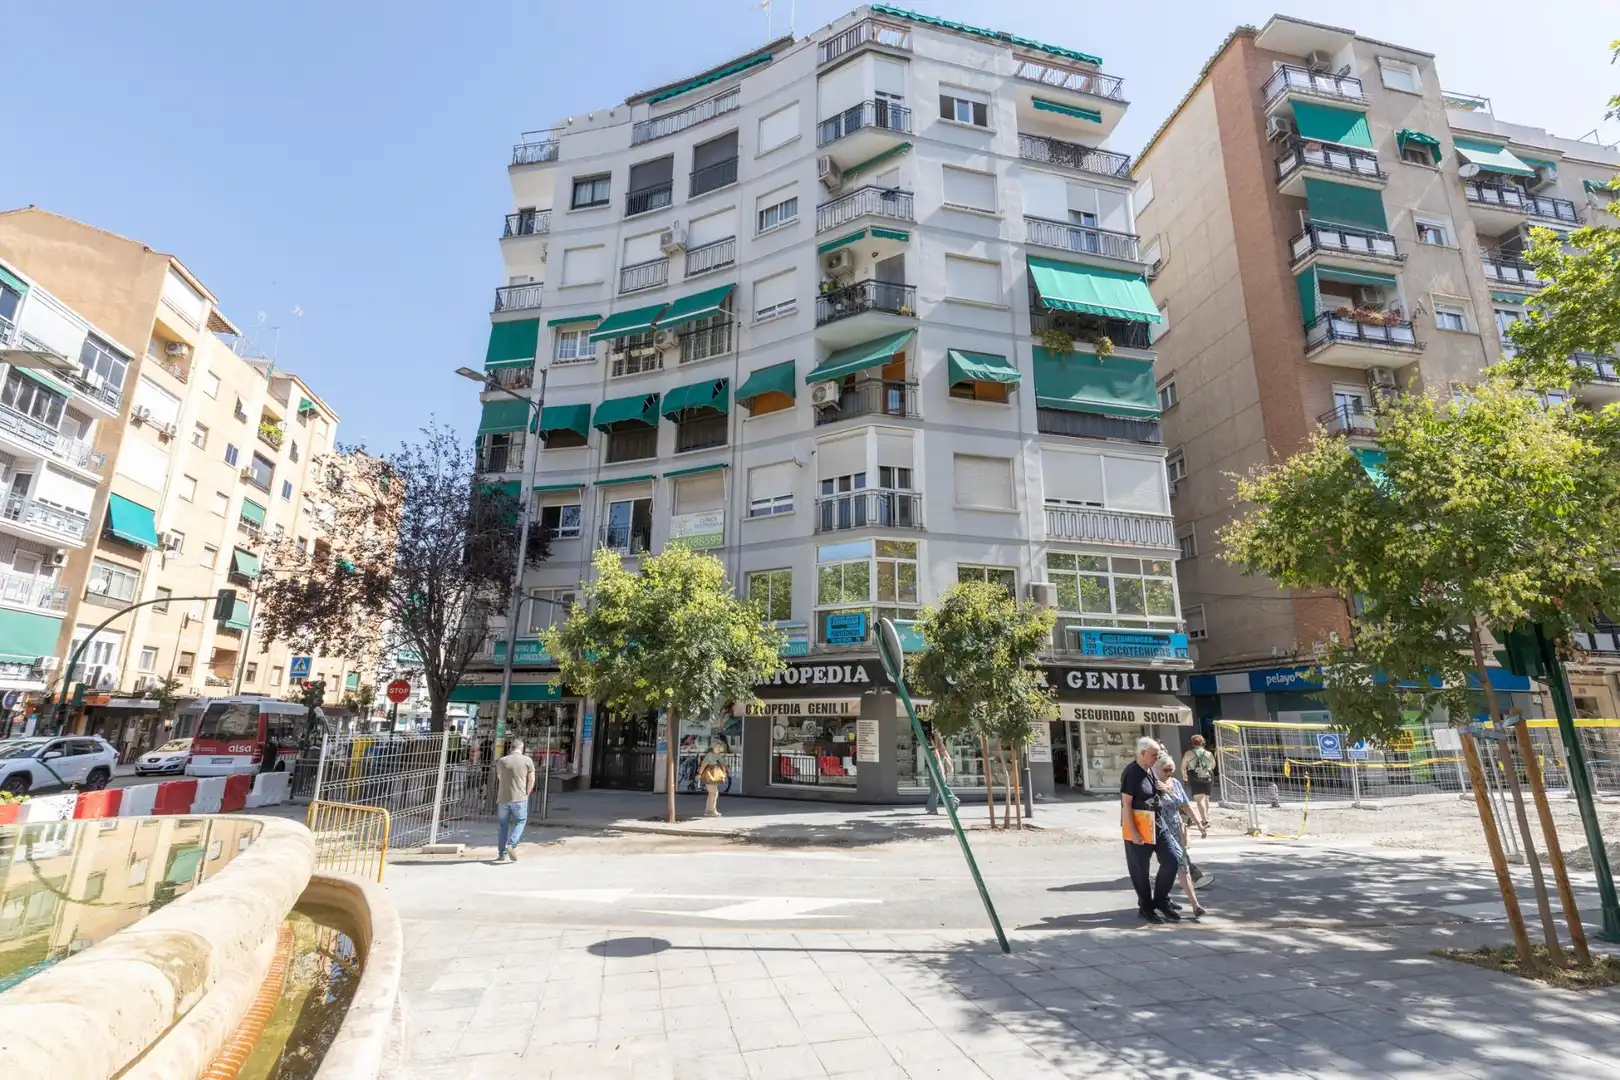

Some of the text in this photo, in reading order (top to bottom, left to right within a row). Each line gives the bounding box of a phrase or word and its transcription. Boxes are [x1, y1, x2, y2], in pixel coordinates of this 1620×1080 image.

[1066, 671, 1145, 690] GENIL
[1159, 674, 1179, 691] II
[1265, 673, 1295, 686] pelayo
[808, 702, 838, 714] GENIL
[840, 702, 849, 714] II
[1074, 708, 1181, 723] SEGURIDAD SOCIAL
[228, 744, 252, 753] alsa
